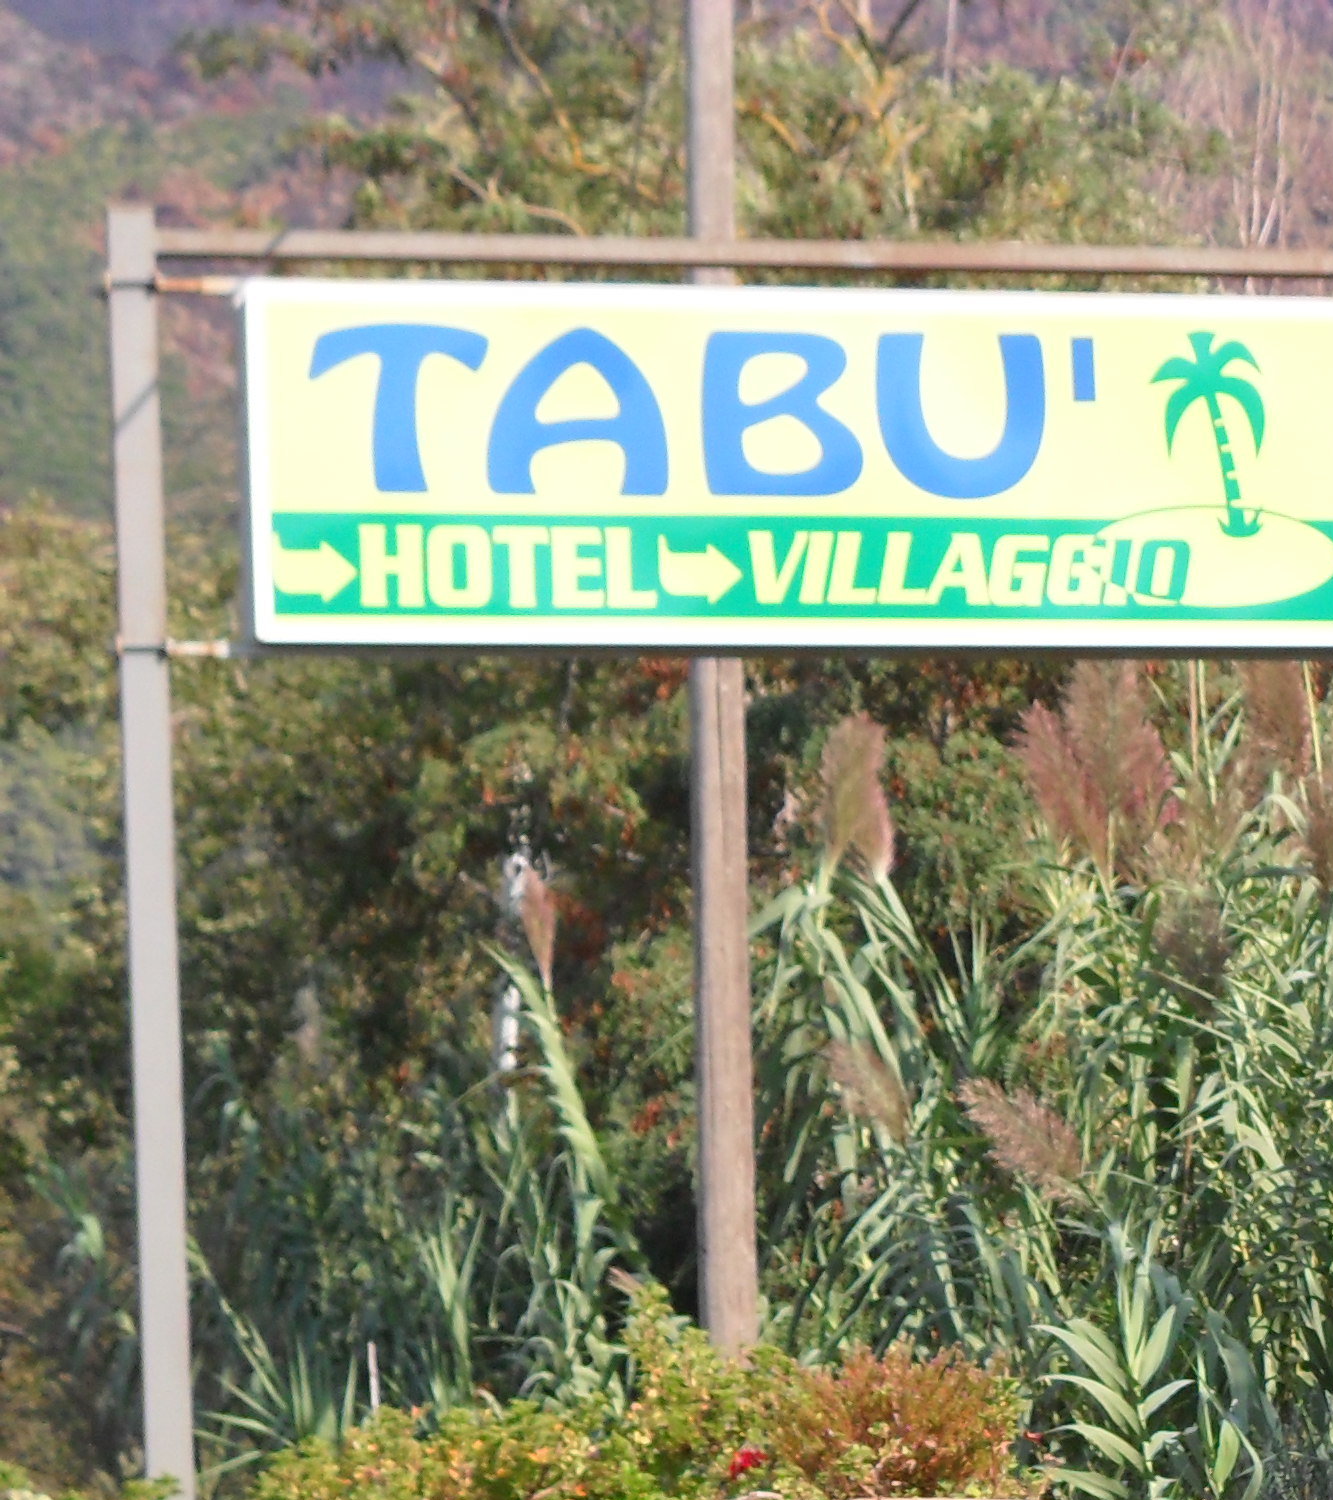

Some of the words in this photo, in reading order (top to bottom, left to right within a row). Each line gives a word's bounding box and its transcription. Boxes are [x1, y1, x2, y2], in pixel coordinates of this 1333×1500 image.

[307, 321, 1097, 500] TABU'
[358, 524, 658, 609] HOTEL
[749, 529, 1192, 609] VILLAGGIO
